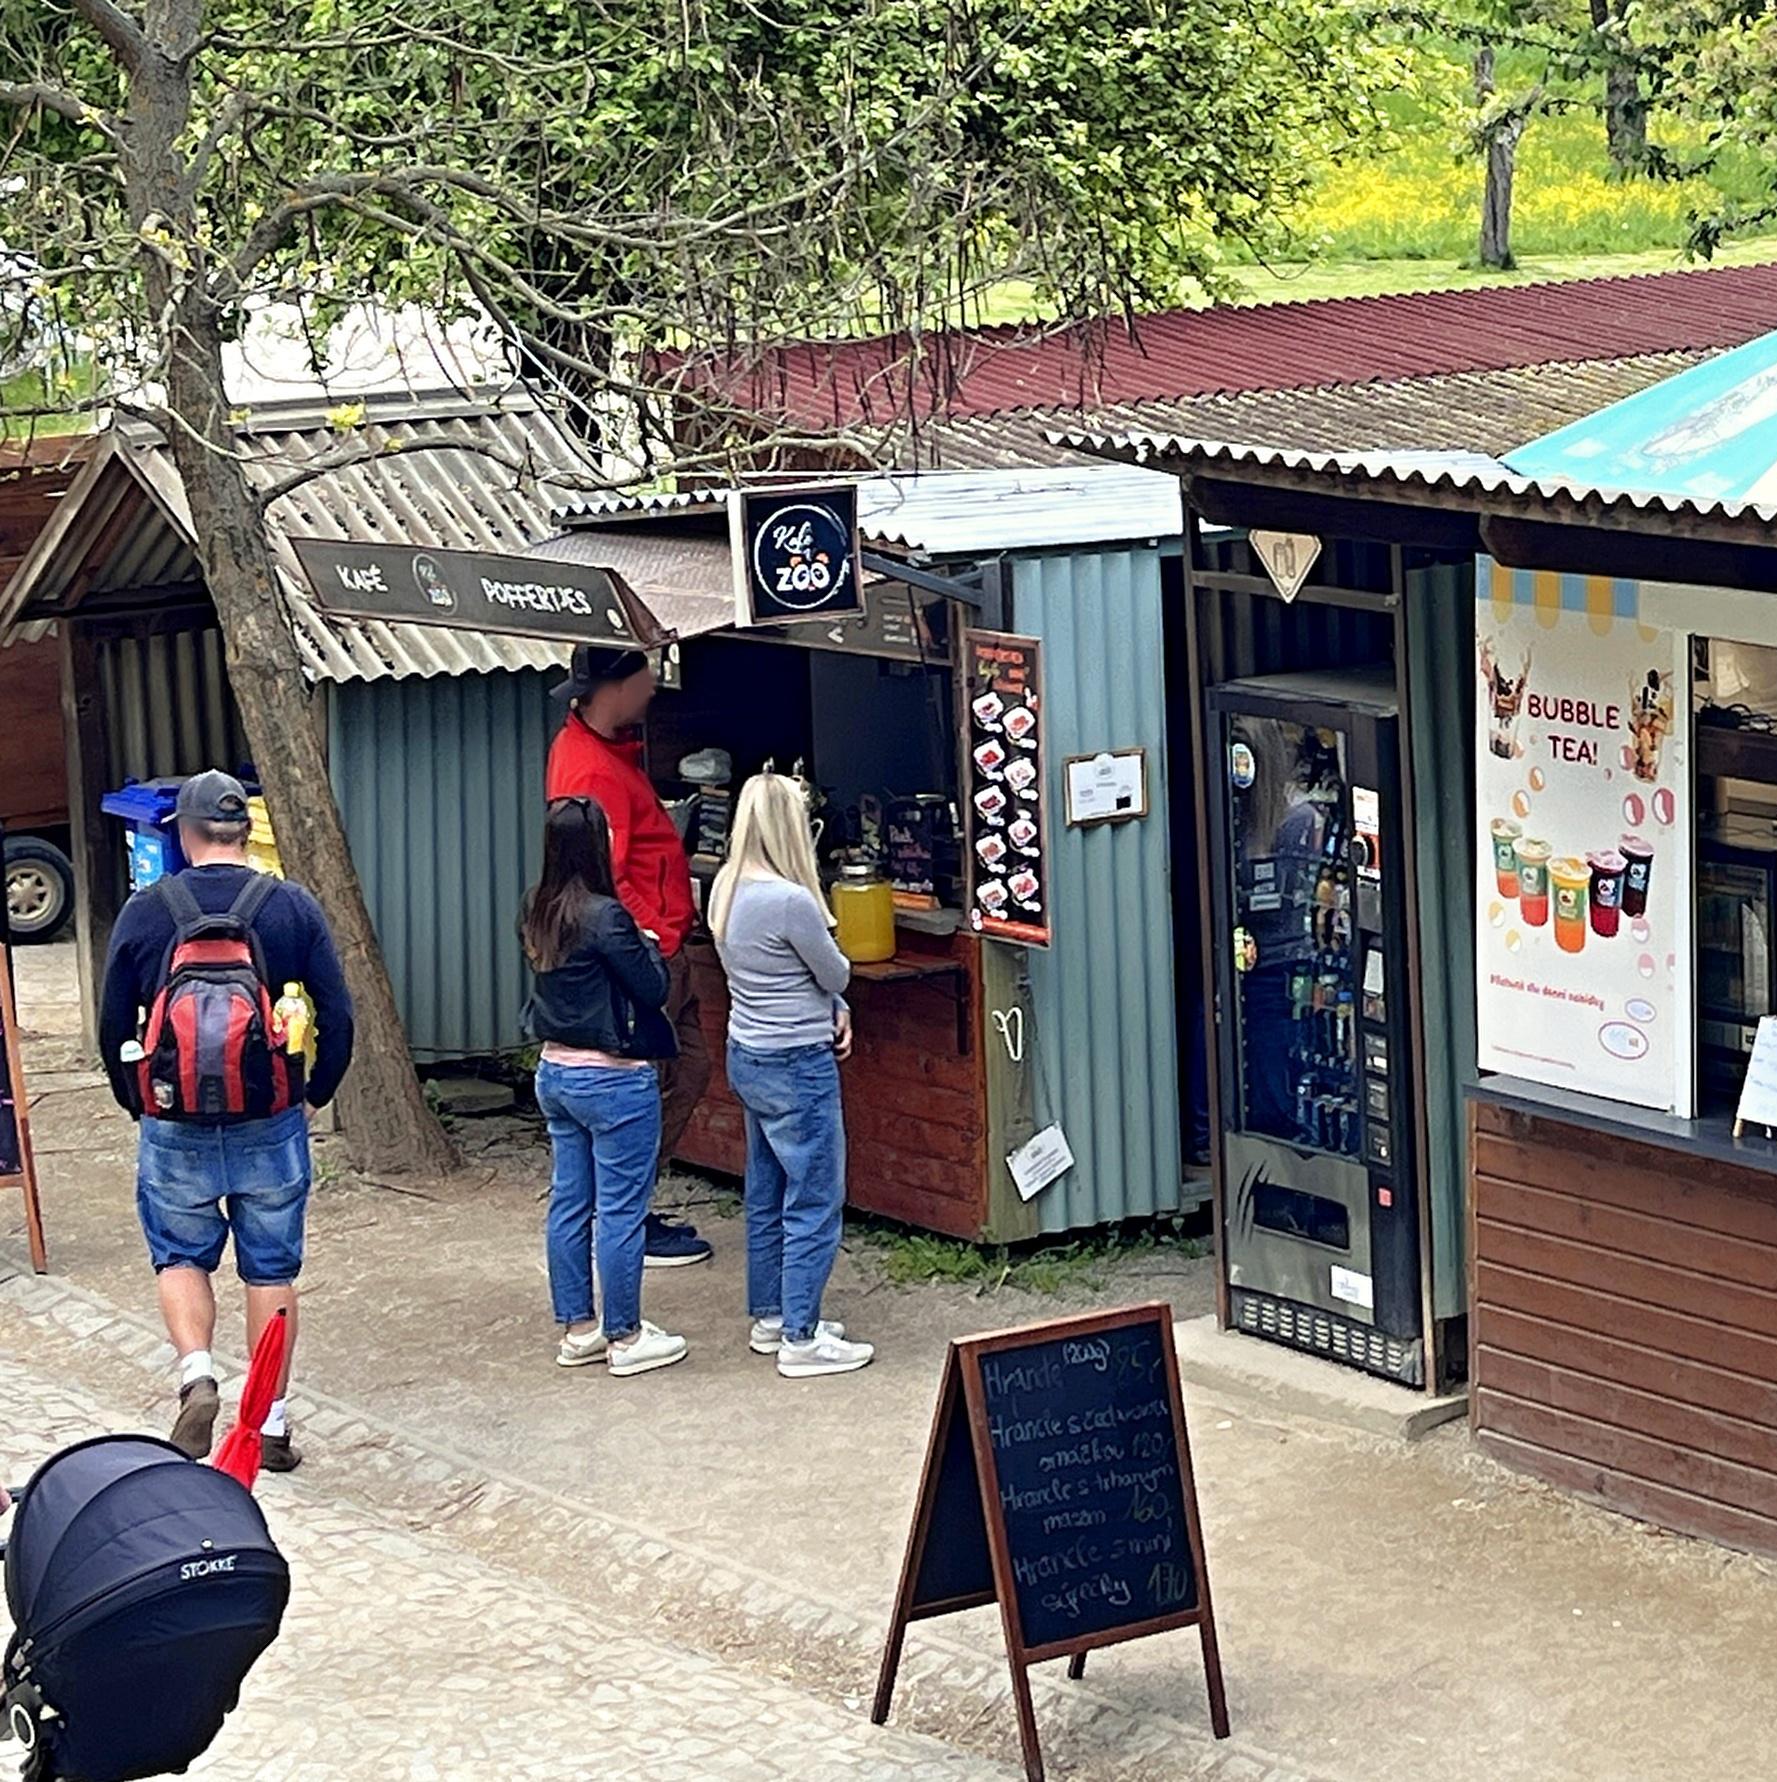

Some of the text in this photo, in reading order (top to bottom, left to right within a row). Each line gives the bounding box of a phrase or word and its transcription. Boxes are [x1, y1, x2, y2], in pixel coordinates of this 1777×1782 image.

[1527, 694, 1620, 729] BUBBLE
[1548, 735, 1598, 766] TEA!
[181, 1555, 237, 1579] STOKKE
